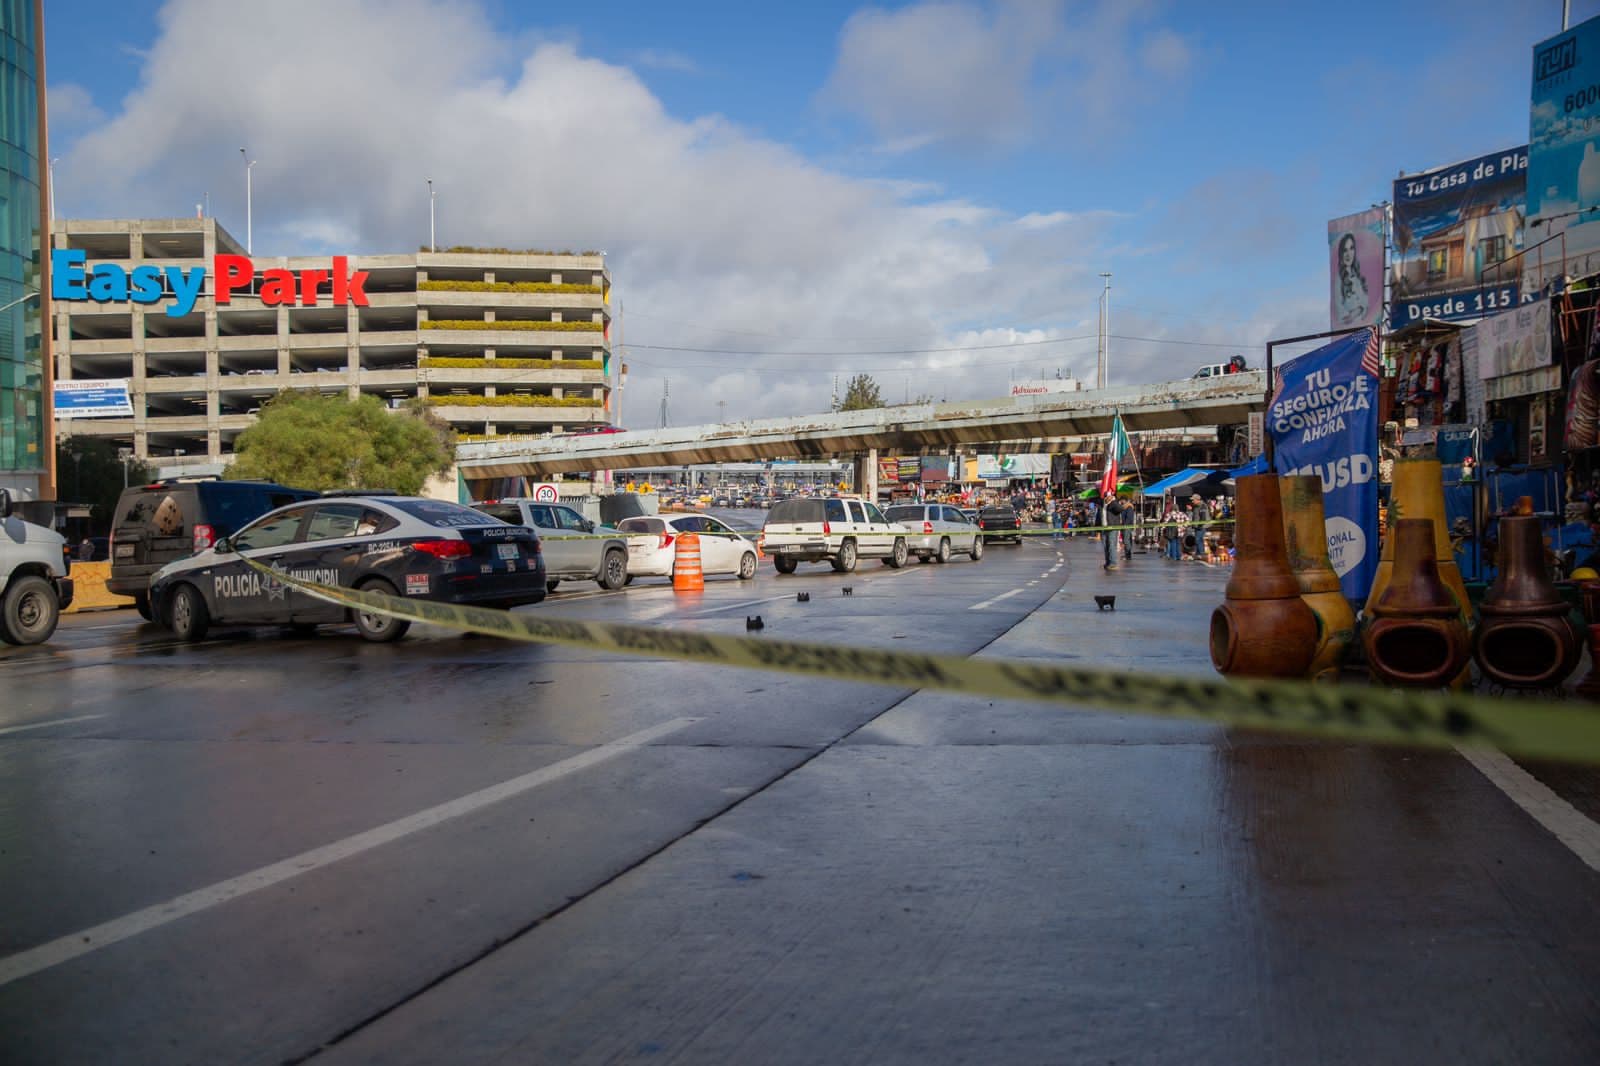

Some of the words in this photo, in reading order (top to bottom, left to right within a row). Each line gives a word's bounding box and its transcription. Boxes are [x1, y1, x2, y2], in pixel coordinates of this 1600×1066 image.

[1564, 84, 1600, 113] 600
[1406, 181, 1425, 198] Tu
[1429, 171, 1467, 191] Casa
[1473, 162, 1495, 180] de
[1408, 298, 1465, 320] Desde
[1474, 289, 1511, 311] 115
[1305, 368, 1330, 391] TU
[1273, 384, 1347, 418] SEGURO
[1275, 394, 1370, 433] CONFIANZA
[1302, 416, 1346, 444] AHORA
[1284, 453, 1373, 493] USD
[541, 489, 553, 498] 30
[214, 571, 262, 598] POLICÍA
